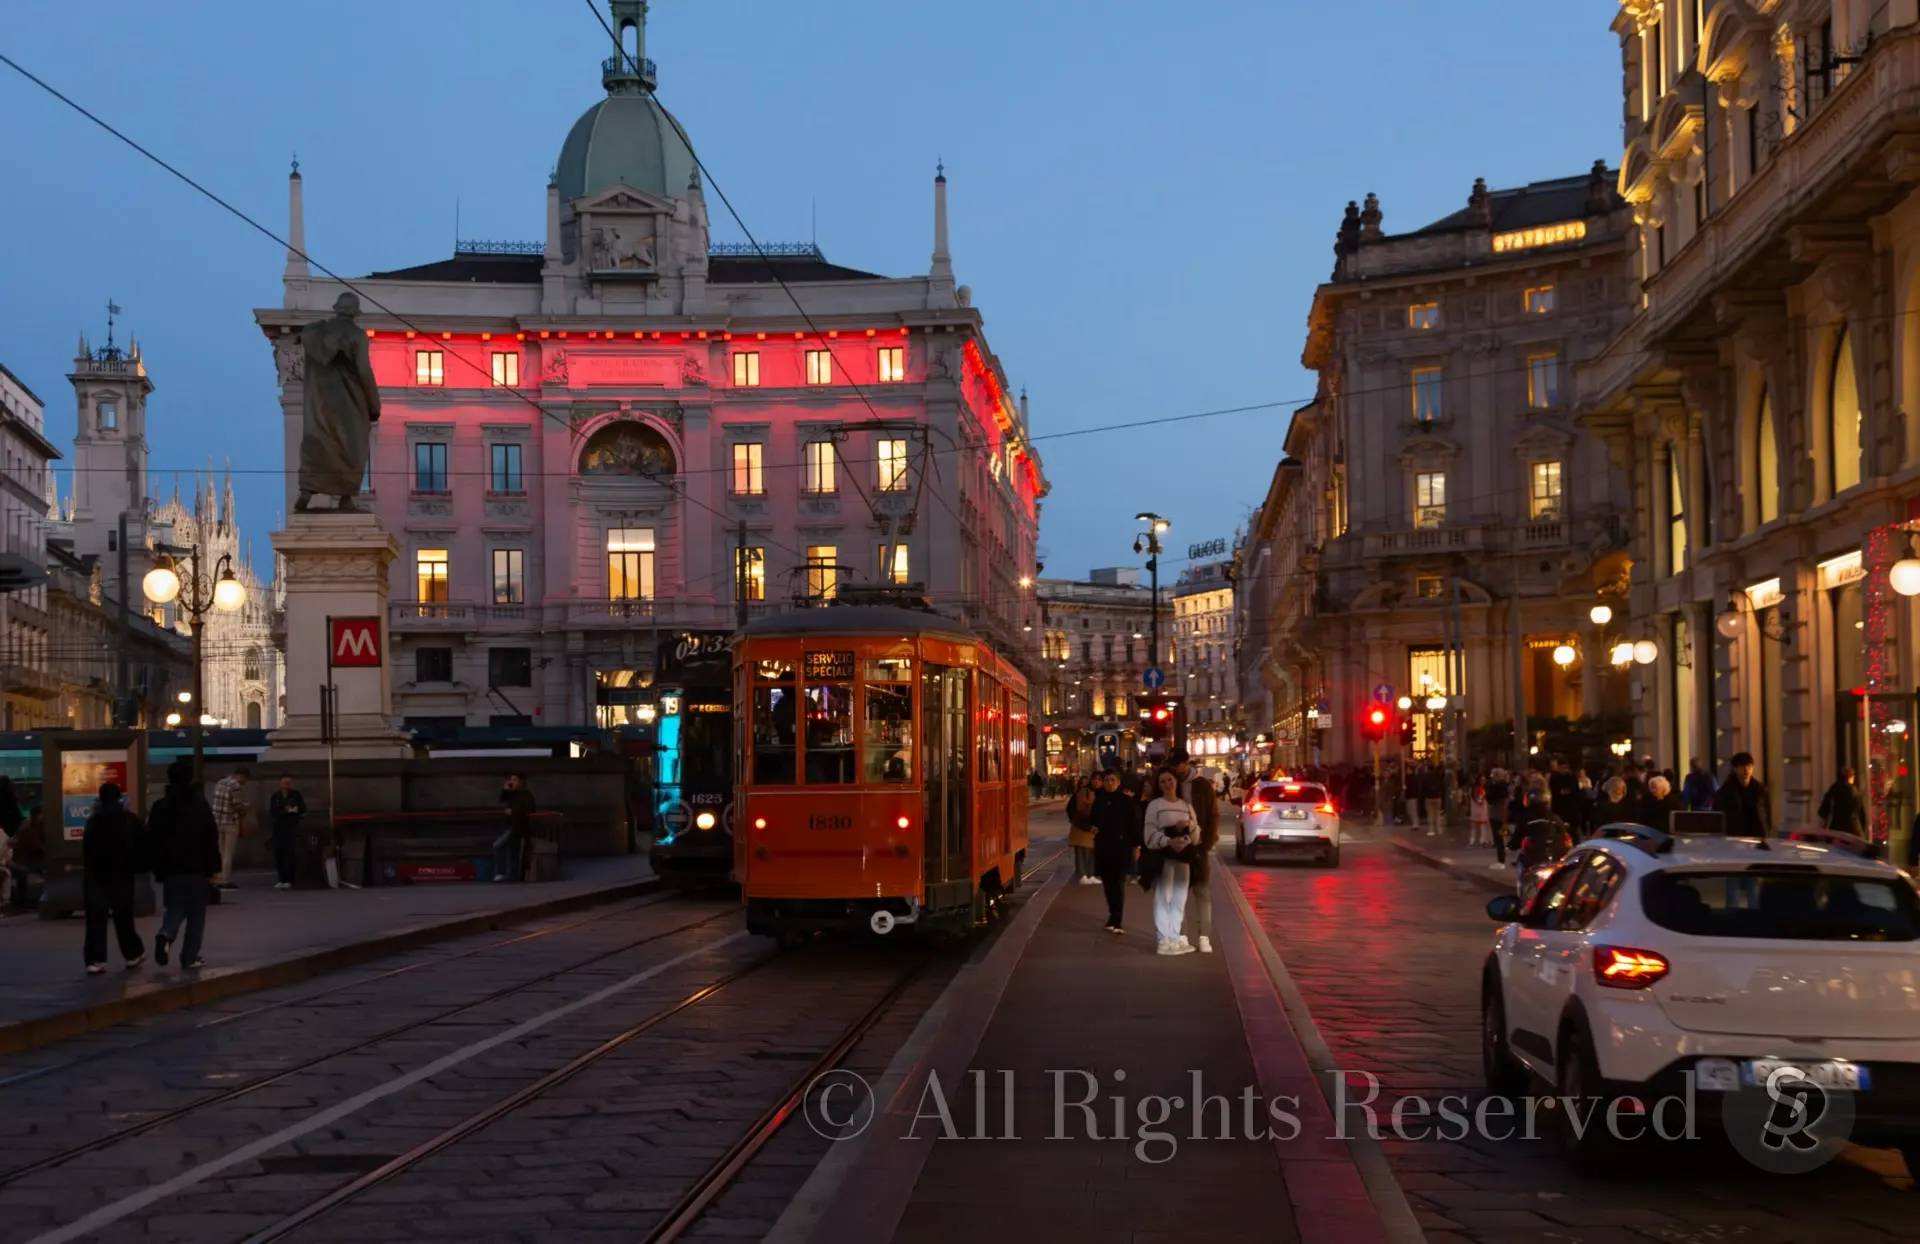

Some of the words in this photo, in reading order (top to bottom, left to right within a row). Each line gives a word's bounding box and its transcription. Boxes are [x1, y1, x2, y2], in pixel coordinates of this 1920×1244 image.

[1493, 221, 1586, 252] STARBUCKS
[1188, 537, 1226, 560] GUCCI
[336, 628, 377, 657] M
[807, 652, 853, 664] SERVIZIO
[806, 665, 853, 678] SPECIALE
[662, 697, 679, 714] 19
[692, 793, 724, 804] 1625
[809, 814, 853, 830] 1830
